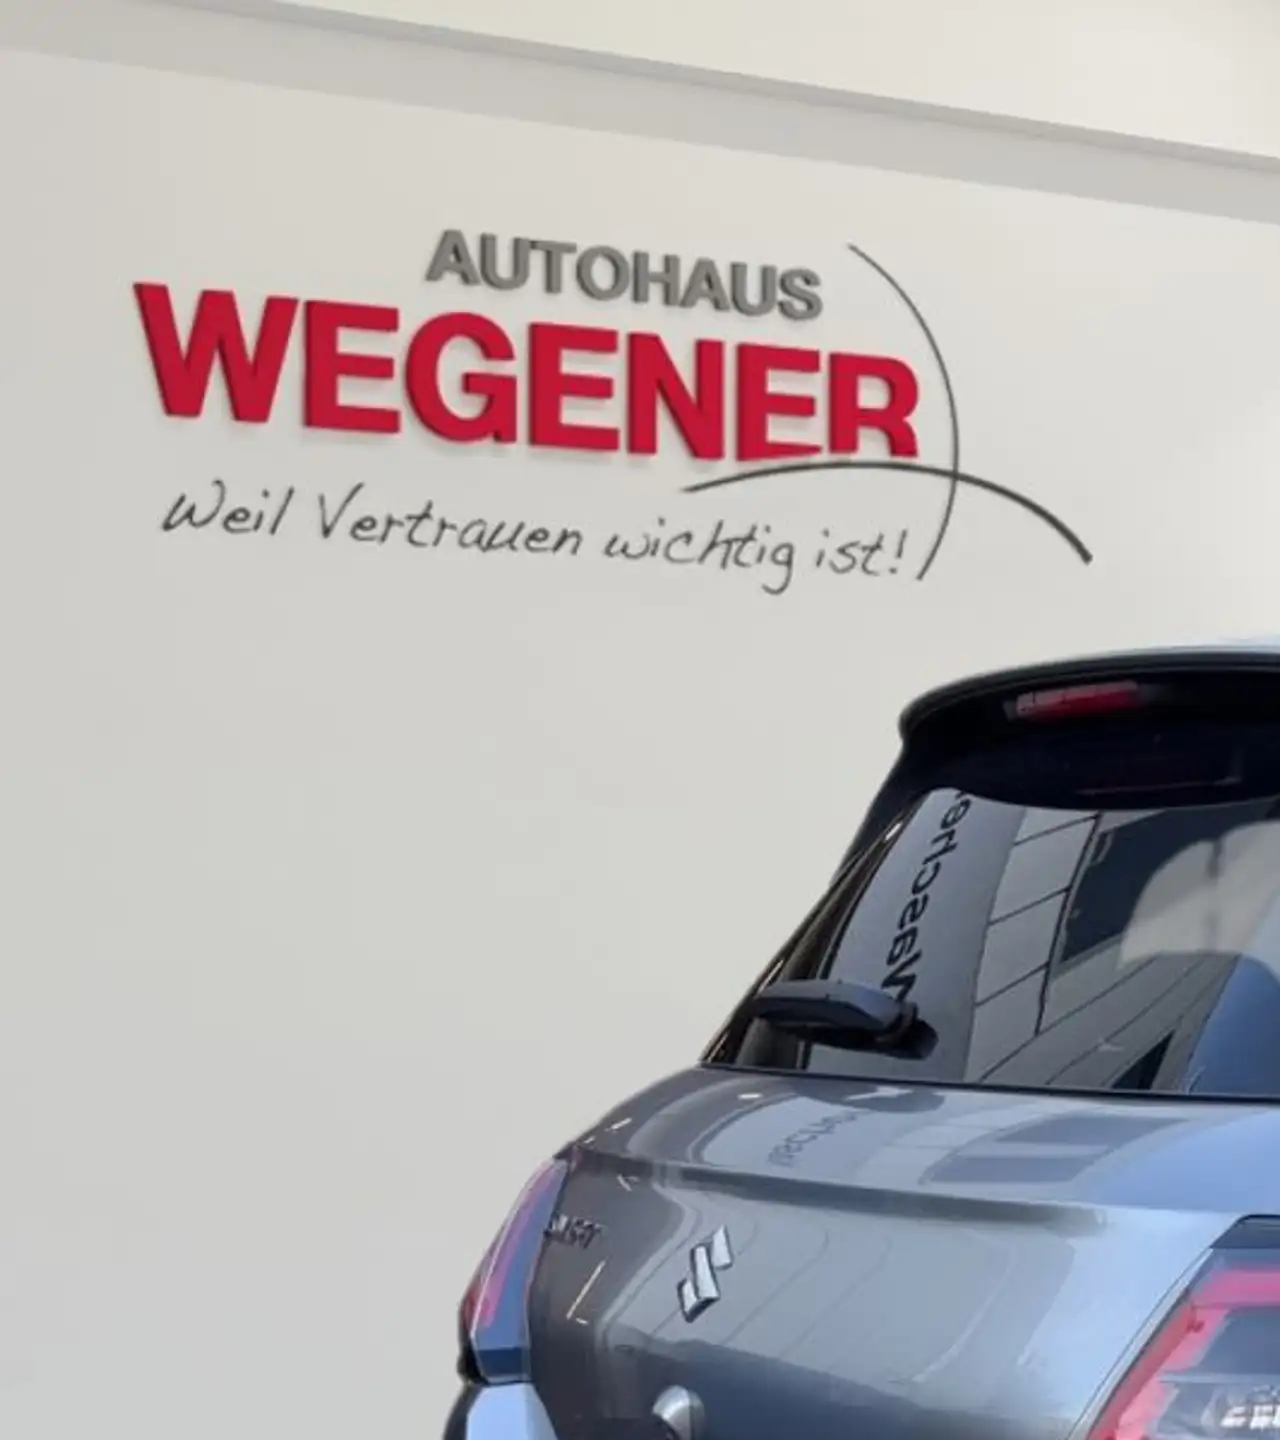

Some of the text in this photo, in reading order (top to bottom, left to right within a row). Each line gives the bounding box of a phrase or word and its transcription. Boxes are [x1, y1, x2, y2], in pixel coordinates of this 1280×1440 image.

[424, 229, 824, 322] AUTOHAUS
[132, 281, 921, 463] WEGENER
[161, 478, 907, 595] Weil Vertrauen wichtig ist!
